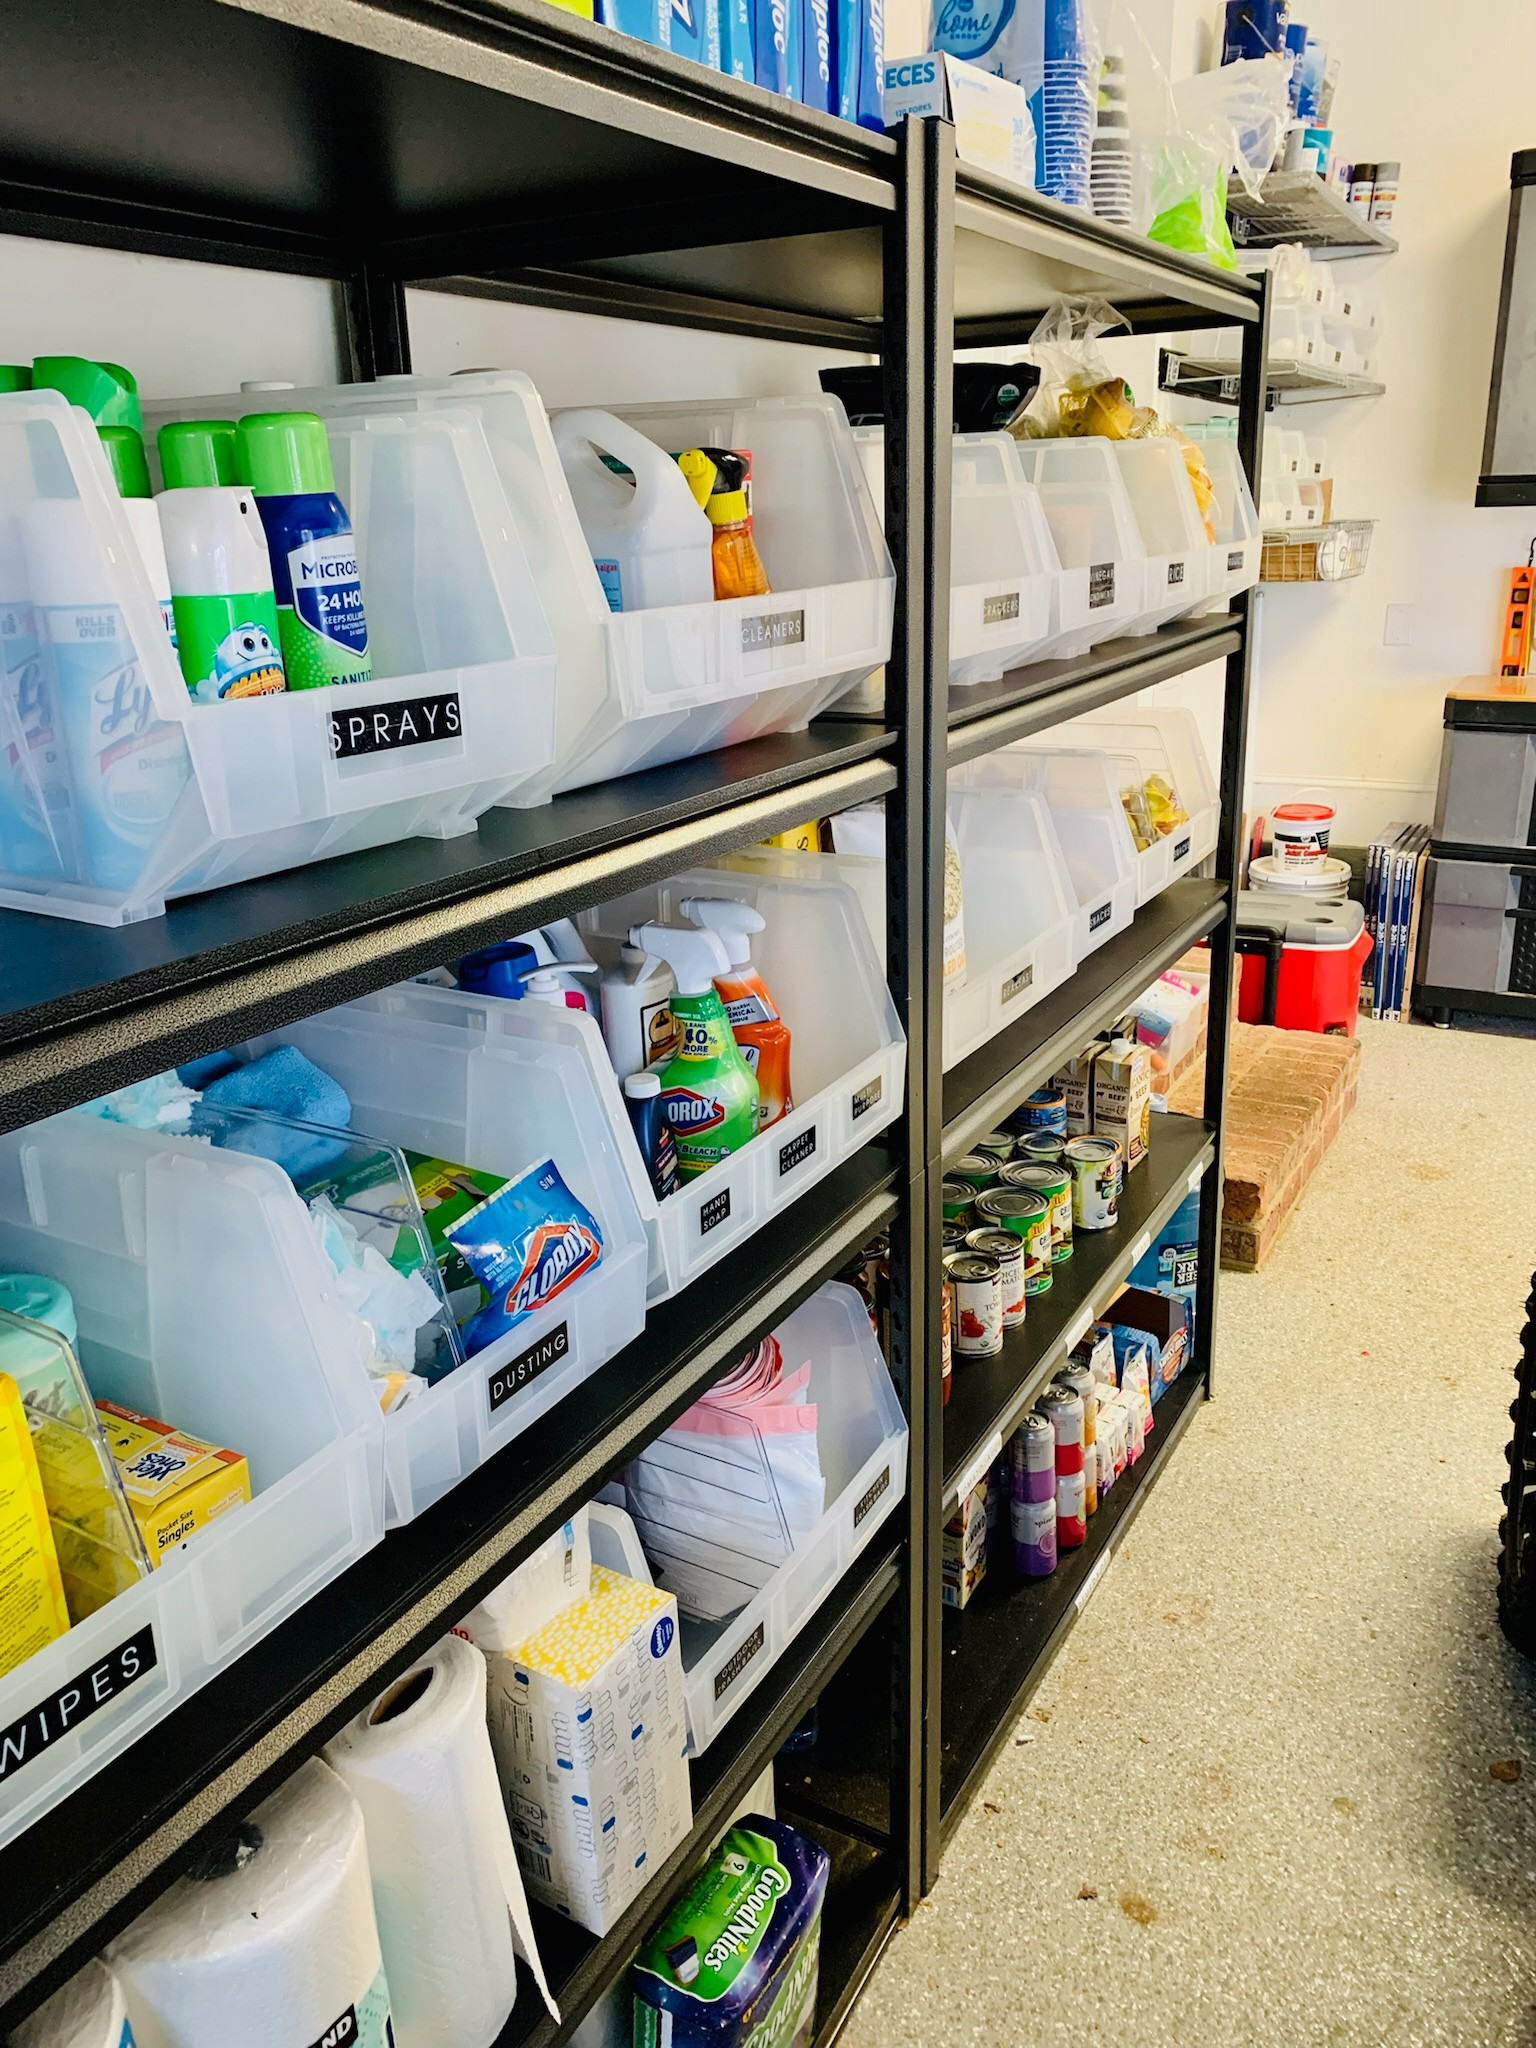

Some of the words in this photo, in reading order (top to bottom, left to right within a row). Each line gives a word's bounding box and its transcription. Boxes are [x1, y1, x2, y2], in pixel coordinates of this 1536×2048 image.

[885, 61, 935, 89] ECES
[908, 103, 932, 114] FORKS
[317, 594, 341, 612] 24
[984, 600, 1019, 617] CRACKERS
[75, 616, 115, 628] KILLS
[322, 613, 346, 625] KEEPS
[79, 626, 116, 638] OVER
[741, 620, 801, 644] CLEANERS
[328, 701, 459, 752] SPRAYS
[1089, 906, 1111, 928] SNACKS
[1055, 1077, 1087, 1089] ORGANIC
[1067, 1088, 1084, 1097] BEEF
[1096, 1082, 1129, 1094] ORGANIC
[854, 1091, 881, 1115] PURPOSE
[1108, 1091, 1126, 1102] BEEF
[667, 1096, 717, 1123] OROX
[682, 1144, 717, 1156] BLEACH
[781, 1133, 808, 1160] CARPET
[781, 1143, 814, 1172] CLEANER
[539, 1174, 556, 1190] S/M
[703, 1193, 727, 1217] HAND
[703, 1208, 727, 1231] SOAP
[511, 1214, 592, 1318] CLOROX
[493, 1333, 566, 1400] DUSTING
[126, 1462, 169, 1482] Wet
[141, 1453, 187, 1472] Ones
[157, 1518, 179, 1537] Pocket
[179, 1509, 194, 1522] Size
[158, 1519, 196, 1549] Singles
[721, 1631, 759, 1678] OUTDOOR
[716, 1662, 741, 1696] TRASH
[740, 1640, 762, 1670] BAGS
[0, 1646, 140, 1774] WIPES
[321, 2015, 352, 2048] ND
